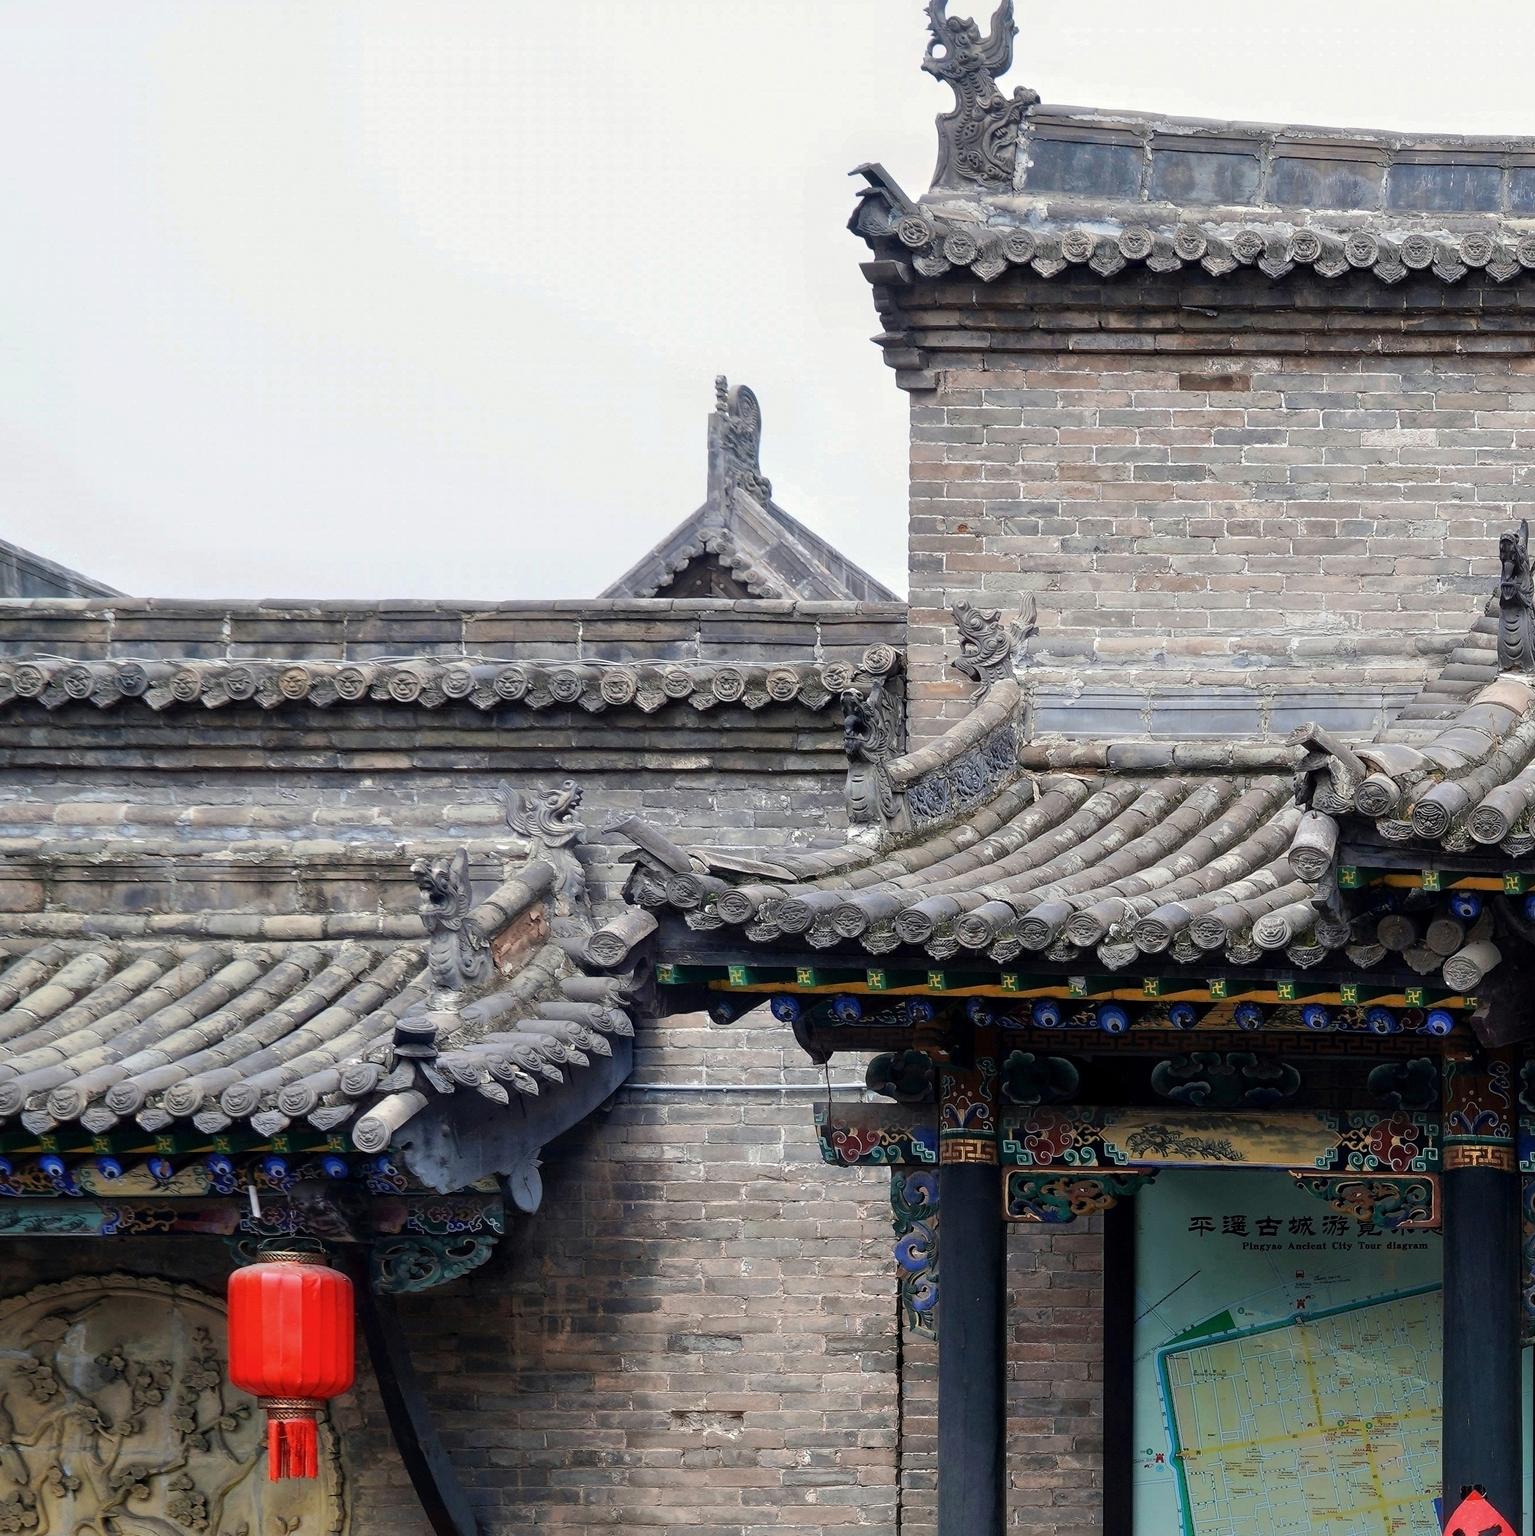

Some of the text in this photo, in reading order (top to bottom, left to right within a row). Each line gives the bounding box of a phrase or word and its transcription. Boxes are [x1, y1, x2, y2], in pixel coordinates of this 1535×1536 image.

[1242, 1241, 1428, 1251] Pingyao Ancient City Tour diagram
